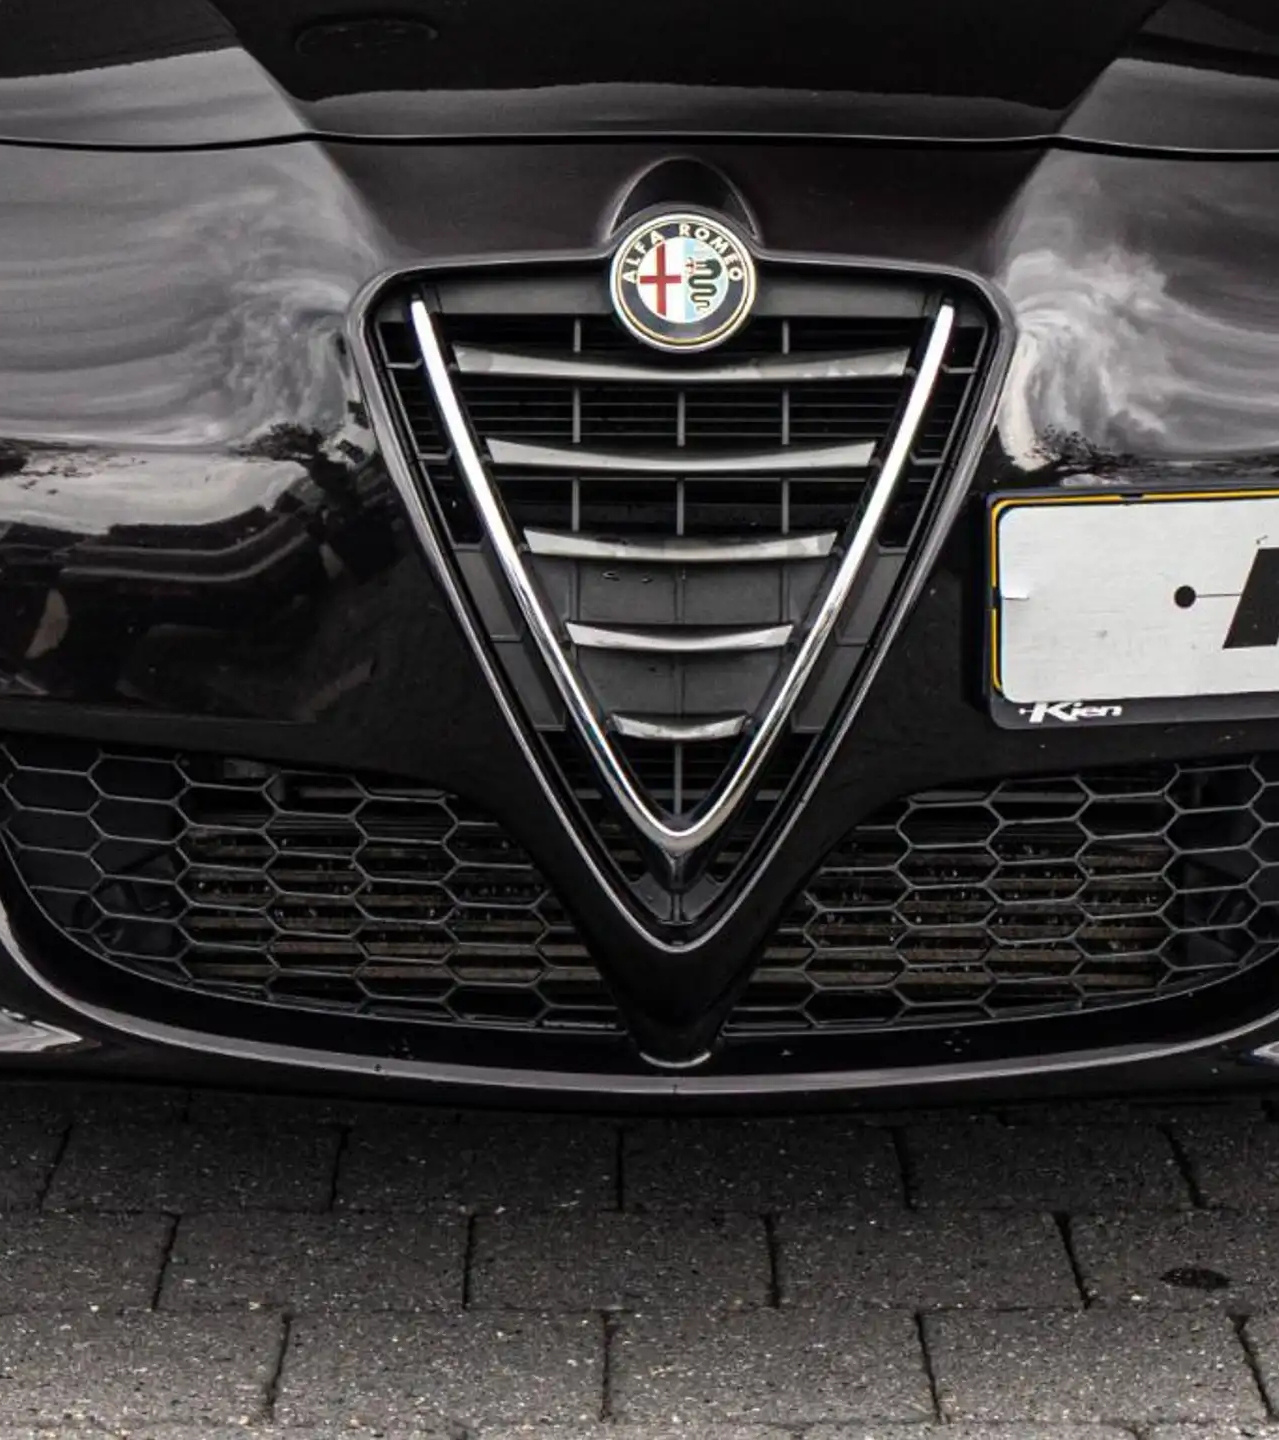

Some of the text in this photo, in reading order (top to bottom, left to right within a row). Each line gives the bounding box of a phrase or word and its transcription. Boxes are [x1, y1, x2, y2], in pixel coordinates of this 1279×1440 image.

[622, 224, 743, 283] ALFA ROMEO
[1029, 702, 1123, 723] Kien
